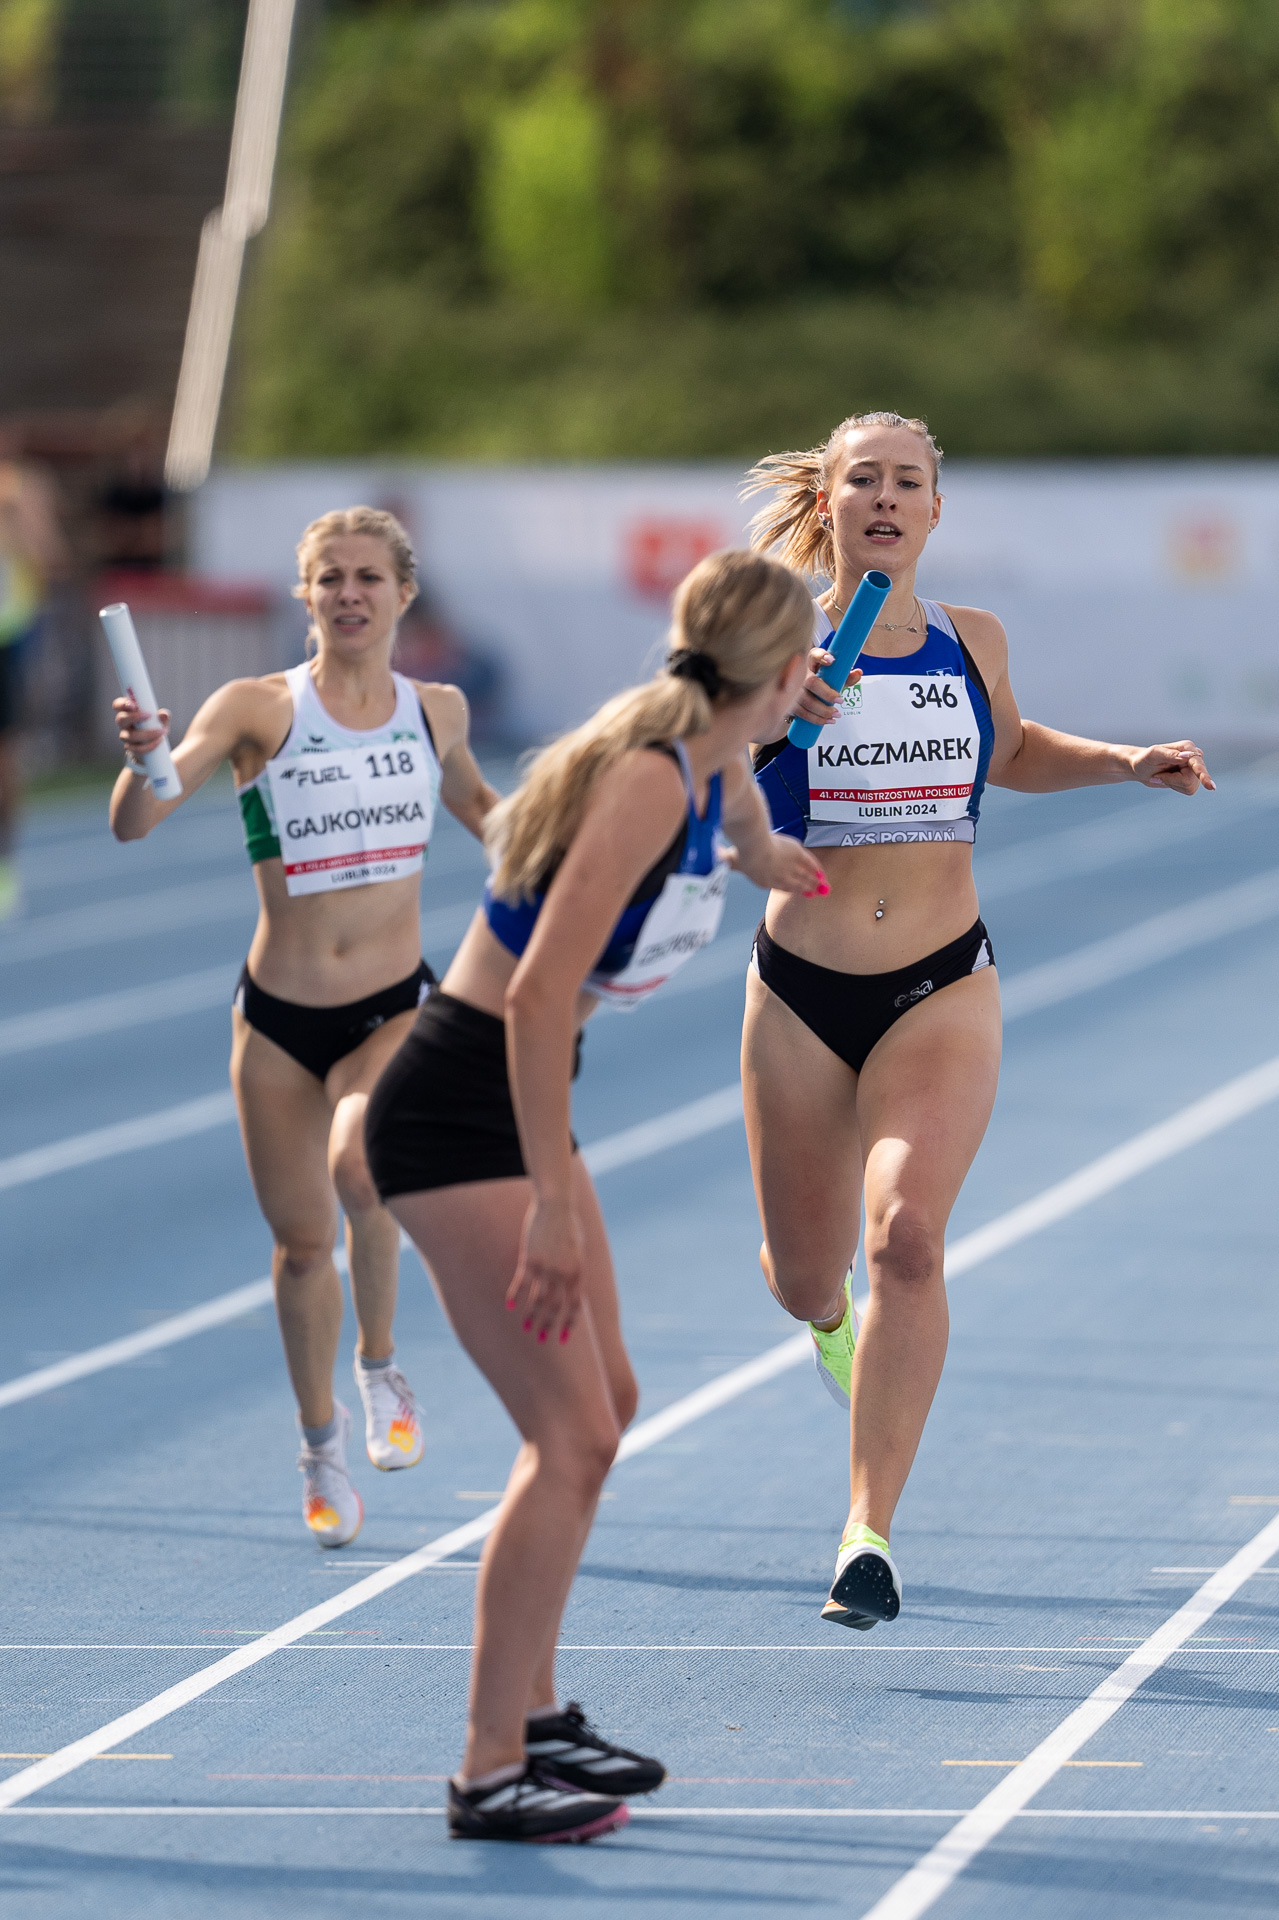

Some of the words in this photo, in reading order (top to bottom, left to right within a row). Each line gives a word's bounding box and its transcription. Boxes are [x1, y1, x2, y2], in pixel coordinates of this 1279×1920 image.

[909, 682, 958, 709] 346
[365, 751, 414, 778] 118
[817, 737, 973, 768] KACZMAREK
[297, 765, 351, 787] FUEL
[819, 791, 832, 799] 41.
[833, 791, 855, 800] PZLA
[857, 789, 923, 801] MISTRZOSTWA
[925, 788, 957, 798] POLSKI
[957, 786, 970, 796] U23
[286, 802, 425, 839] GAJKOWSKA
[858, 805, 902, 818] LUBLIN
[905, 803, 938, 816] 2024
[331, 867, 371, 883] LUBLIN
